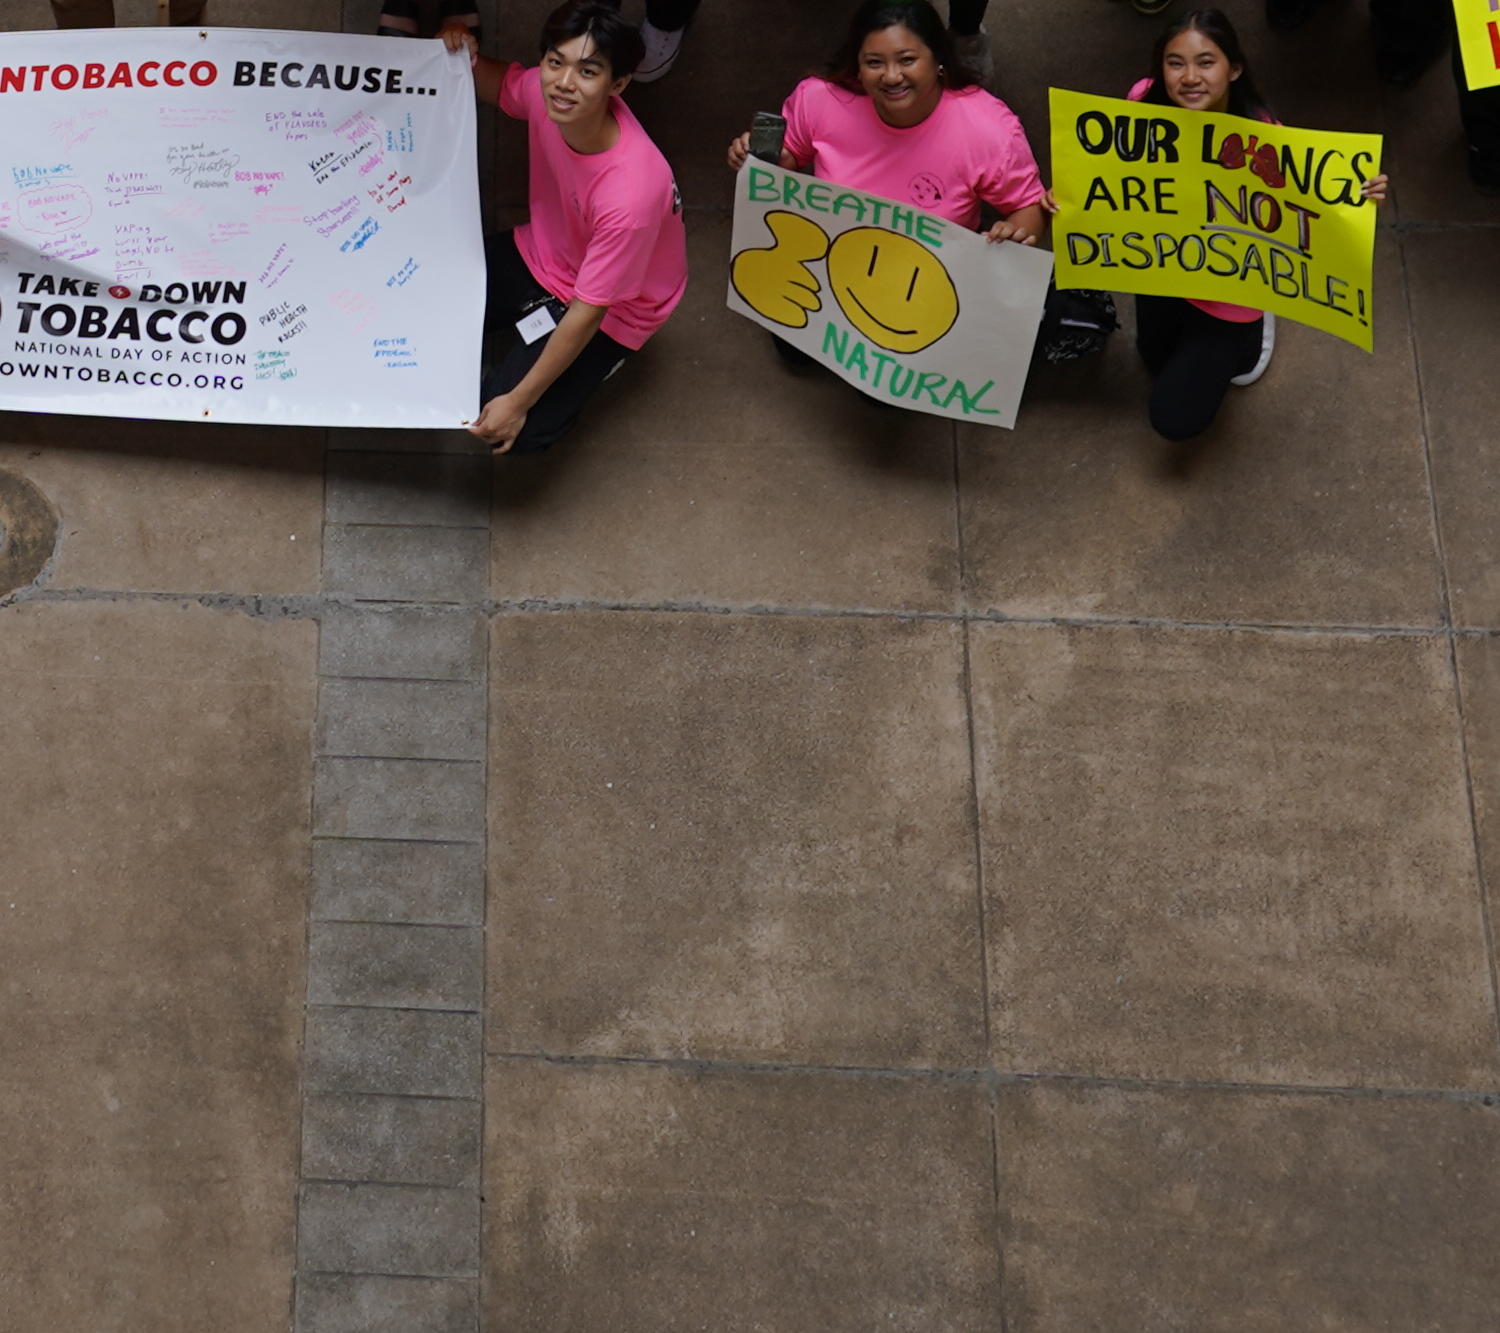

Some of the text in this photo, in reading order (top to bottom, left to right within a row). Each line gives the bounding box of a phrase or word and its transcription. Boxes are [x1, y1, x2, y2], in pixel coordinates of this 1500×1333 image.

[232, 61, 439, 97] BECAUSE...
[1076, 110, 1179, 163] OUR
[749, 166, 947, 247] BREATHE
[17, 272, 246, 305] TAKE DOWN
[1067, 232, 1369, 328] DISPOSABLE!
[17, 302, 246, 345] TOBACCO
[14, 341, 246, 365] NATIONAL DAY OF ACTION
[821, 322, 1001, 415] NATURAL
